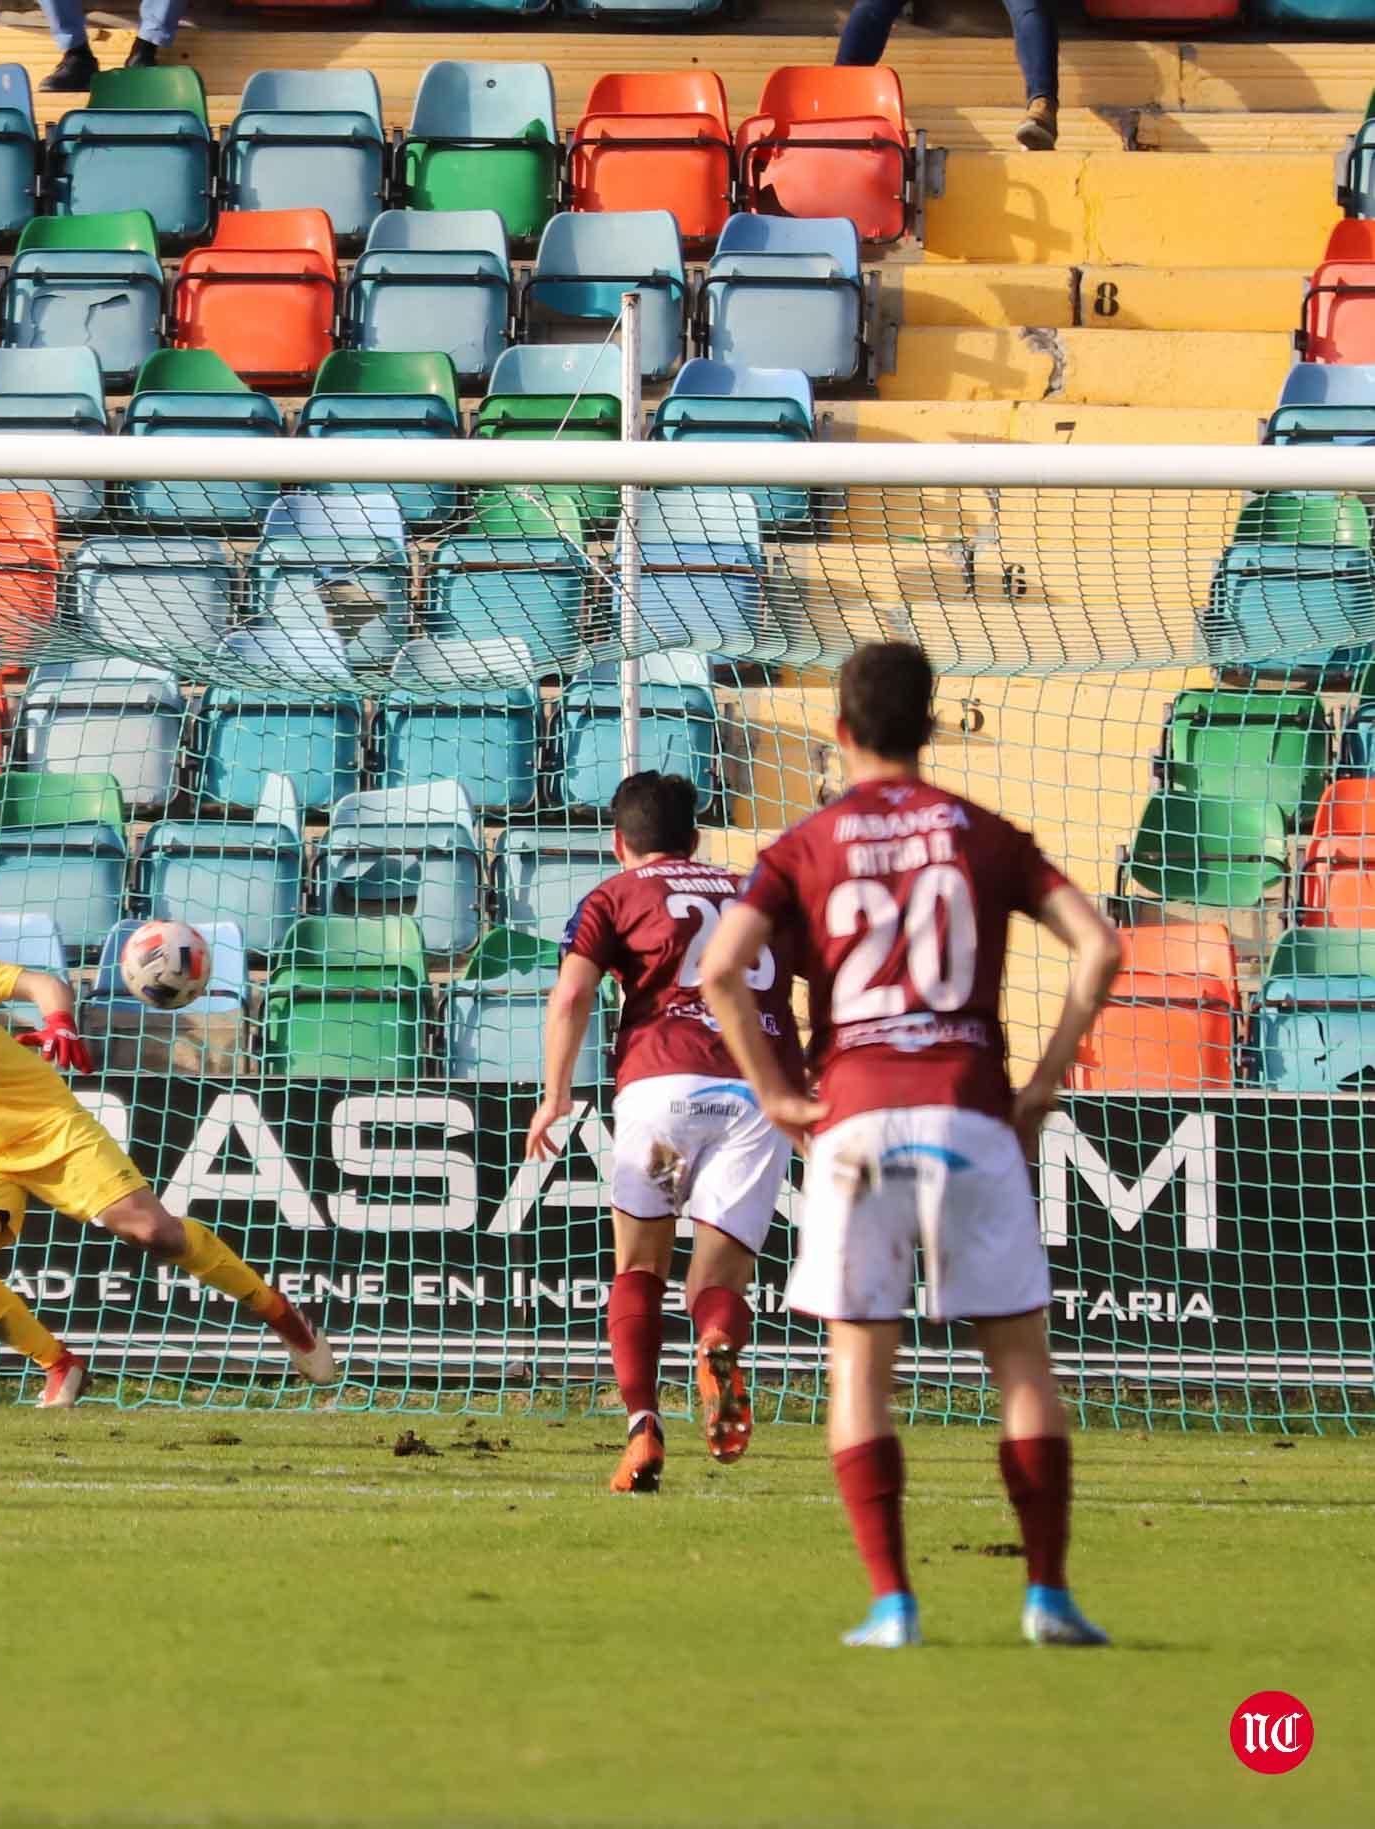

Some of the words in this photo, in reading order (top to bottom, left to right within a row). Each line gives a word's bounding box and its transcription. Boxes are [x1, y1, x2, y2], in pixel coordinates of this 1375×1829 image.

[1094, 282, 1119, 316] 8
[1055, 422, 1076, 444] 7
[1002, 563, 1026, 599] 6
[827, 863, 978, 1025] 20
[99, 1270, 131, 1302] E
[413, 1275, 485, 1307] EN
